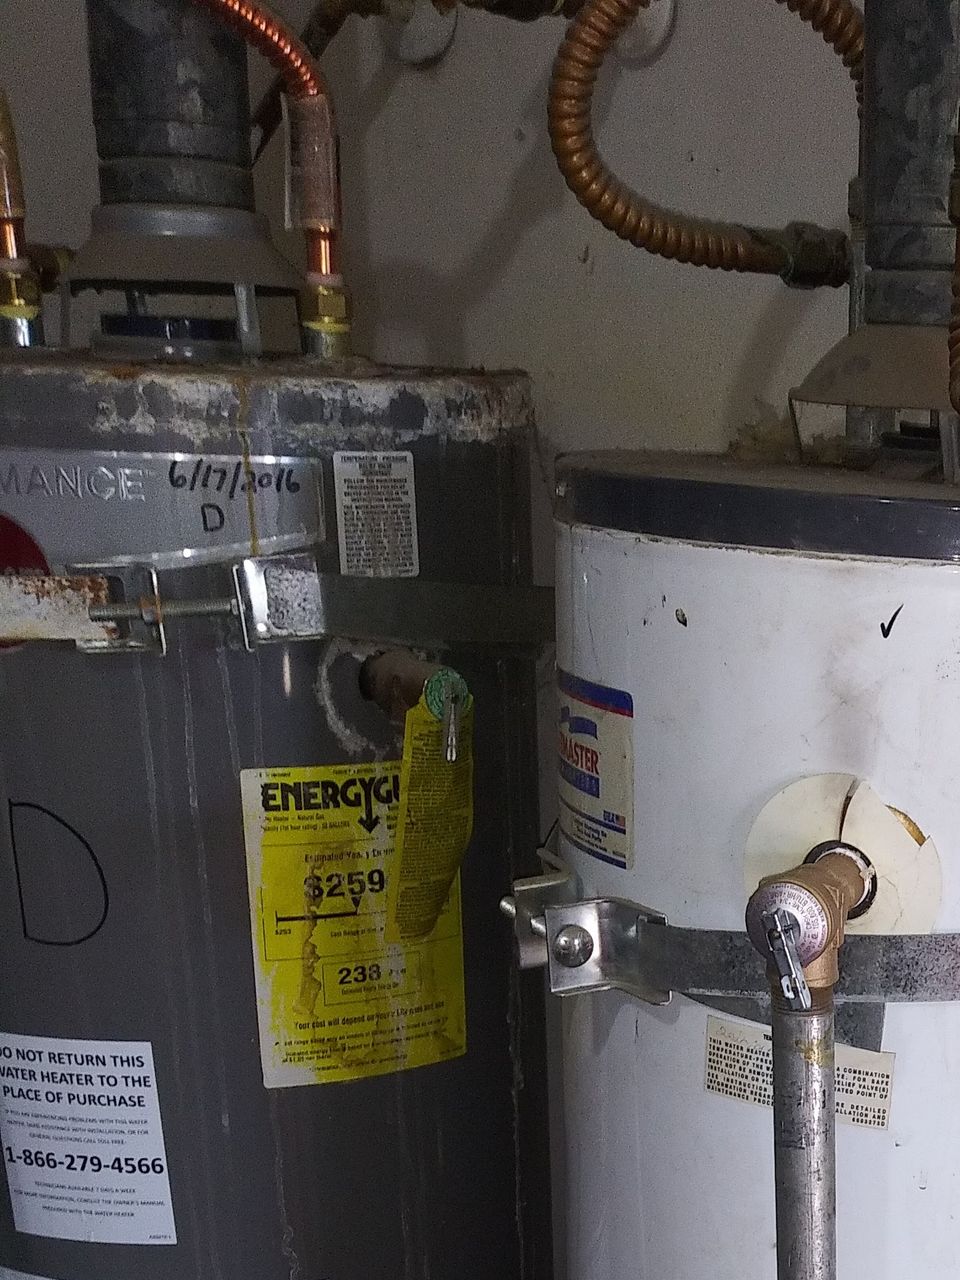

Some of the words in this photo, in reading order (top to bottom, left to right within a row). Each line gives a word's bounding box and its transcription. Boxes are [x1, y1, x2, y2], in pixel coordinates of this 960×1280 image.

[201, 502, 224, 532] D
[8, 798, 109, 946] D
[709, 1037, 721, 1045] THIS
[725, 1042, 743, 1051] WATER
[747, 1049, 769, 1057] HEATER
[16, 1048, 44, 1063] NOT
[49, 1052, 106, 1067] RETURN
[110, 1055, 145, 1068] THIS
[709, 1051, 739, 1063] OPERATION
[40, 1070, 94, 1086] HEATER
[98, 1074, 118, 1087] TO
[121, 1075, 152, 1088] THE
[708, 1064, 748, 1080] INSTALLATION
[844, 1067, 890, 1079] COMBINATION
[707, 1078, 746, 1093] INFORMATION
[707, 1084, 749, 1100] MAINTENANCE
[723, 1076, 767, 1092] INSTRUCTION
[859, 1084, 888, 1093] VALVE(S)
[3, 1086, 41, 1101] PLACE
[45, 1091, 64, 1103] OF
[68, 1092, 146, 1107] PURCHASE
[857, 1090, 876, 1098] POINT
[851, 1104, 886, 1114] DETAILED
[5, 1146, 164, 1174] 1-866-279-4566
